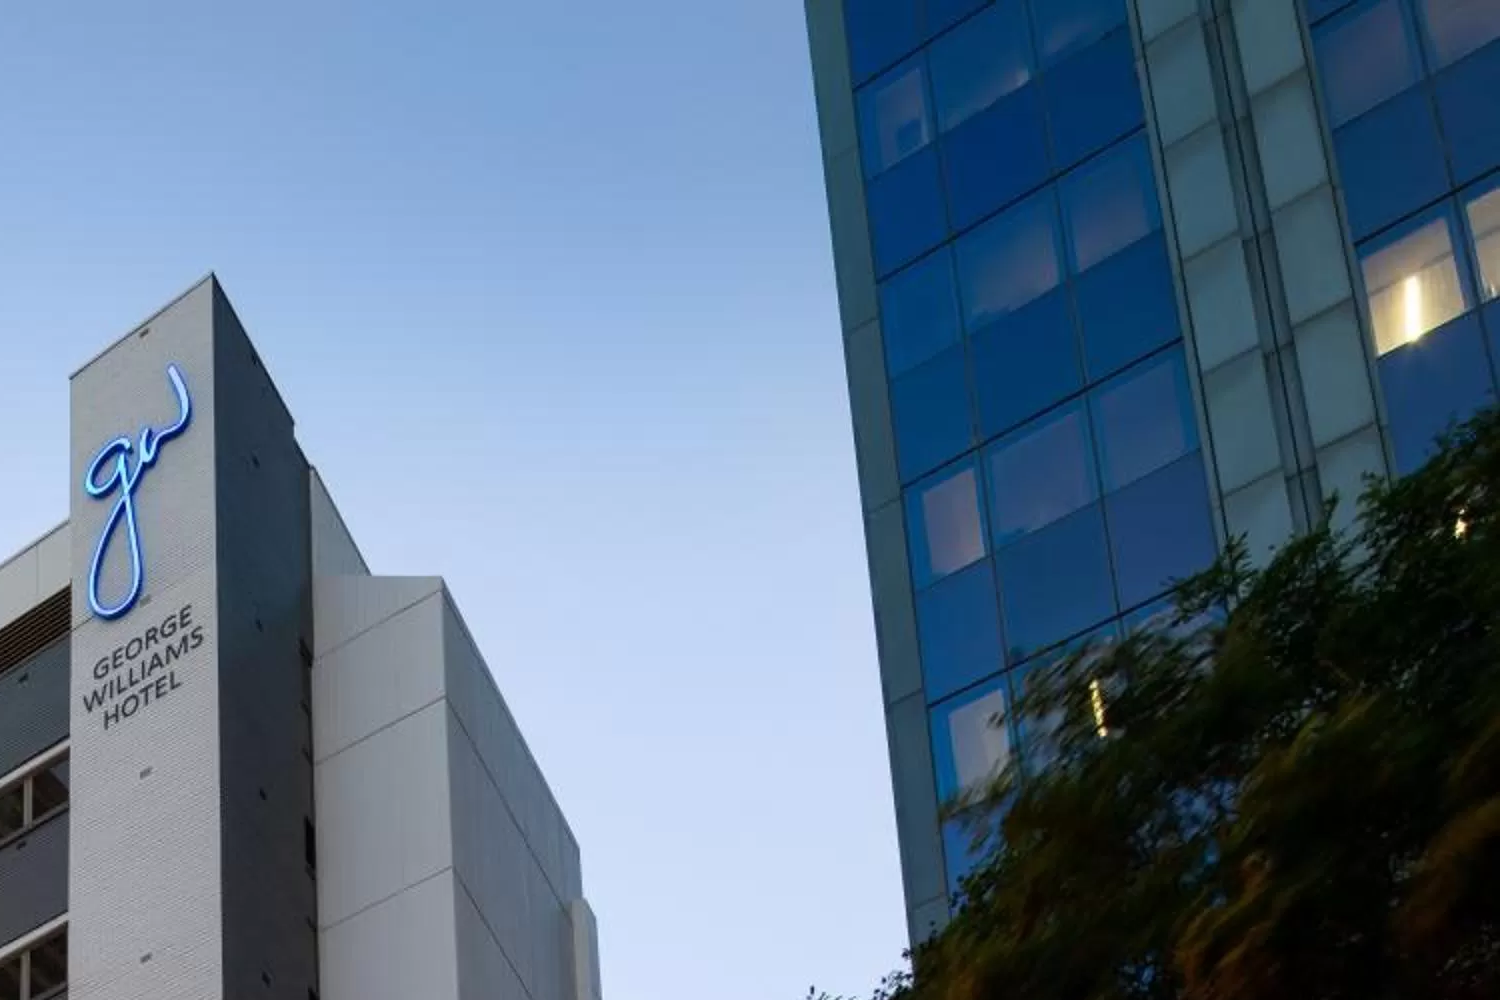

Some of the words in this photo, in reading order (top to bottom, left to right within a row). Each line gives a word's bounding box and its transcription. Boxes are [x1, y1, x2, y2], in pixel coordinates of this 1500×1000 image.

[85, 362, 192, 622] gw
[83, 625, 204, 713] WILLIAMS
[93, 604, 192, 680] GEORGE
[103, 671, 183, 730] HOTEL
